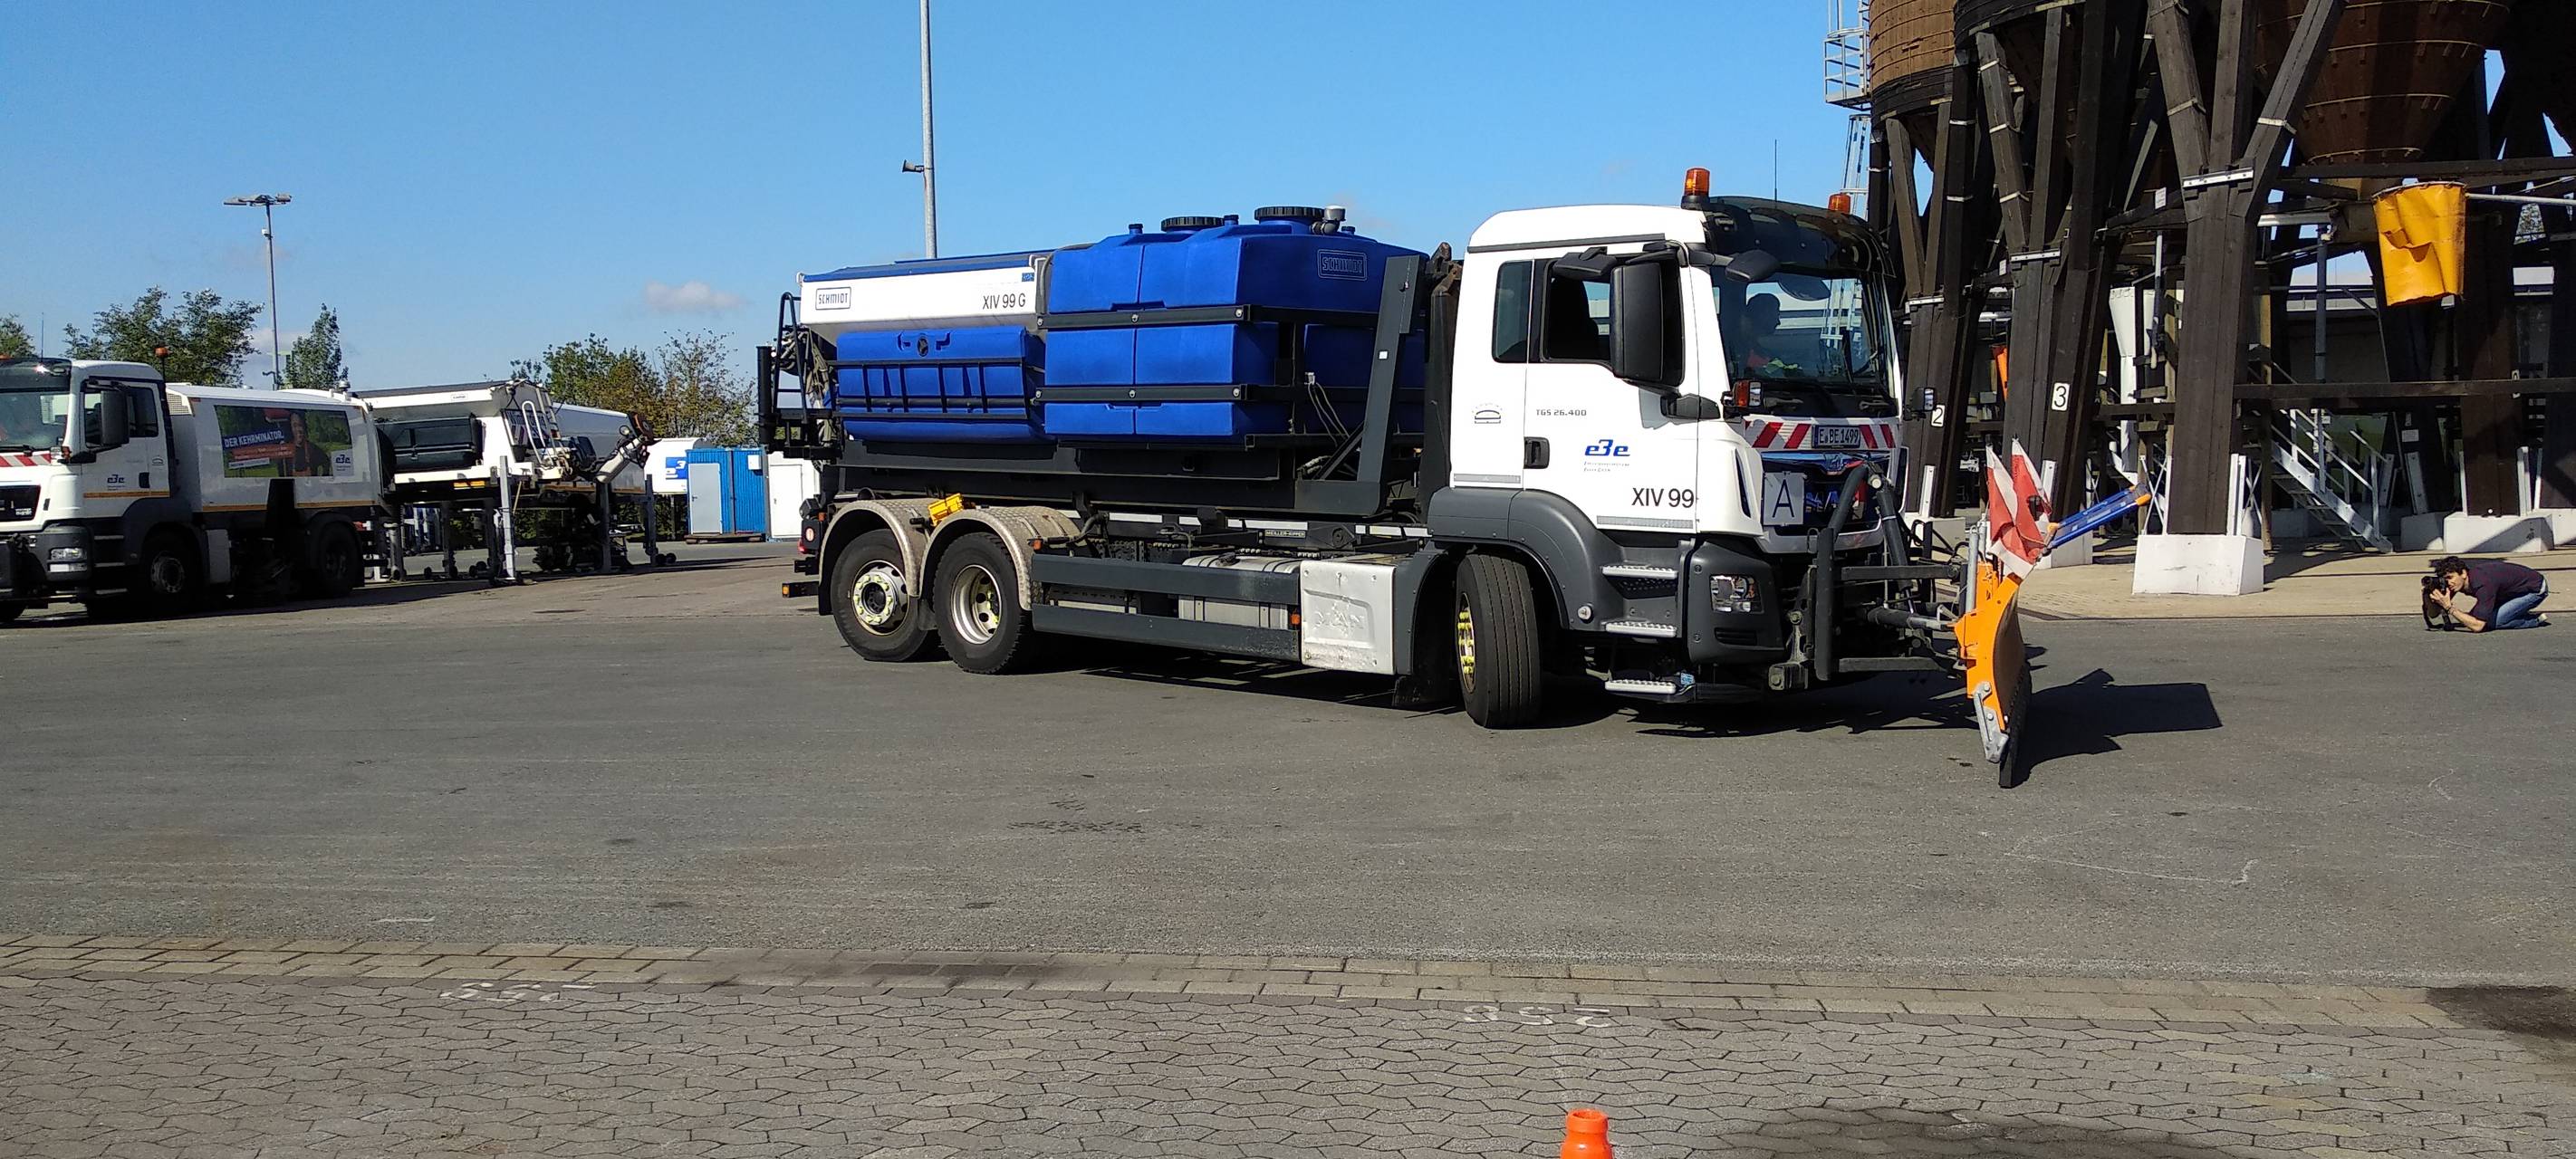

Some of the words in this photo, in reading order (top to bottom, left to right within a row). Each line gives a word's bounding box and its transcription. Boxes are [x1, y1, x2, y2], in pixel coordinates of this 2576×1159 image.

[1322, 256, 1363, 273] SCHMIDT
[818, 292, 850, 305] SCHMIDT
[982, 294, 1000, 310] XIV
[1002, 293, 1015, 308] 99
[1018, 292, 1026, 308] G
[2053, 385, 2067, 407] 3
[1933, 407, 1944, 425] 2
[224, 436, 239, 448] DER
[1829, 428, 1840, 444] BE
[1631, 487, 1665, 507] XIV
[1668, 487, 1695, 509] 99
[1772, 479, 1795, 518] A
